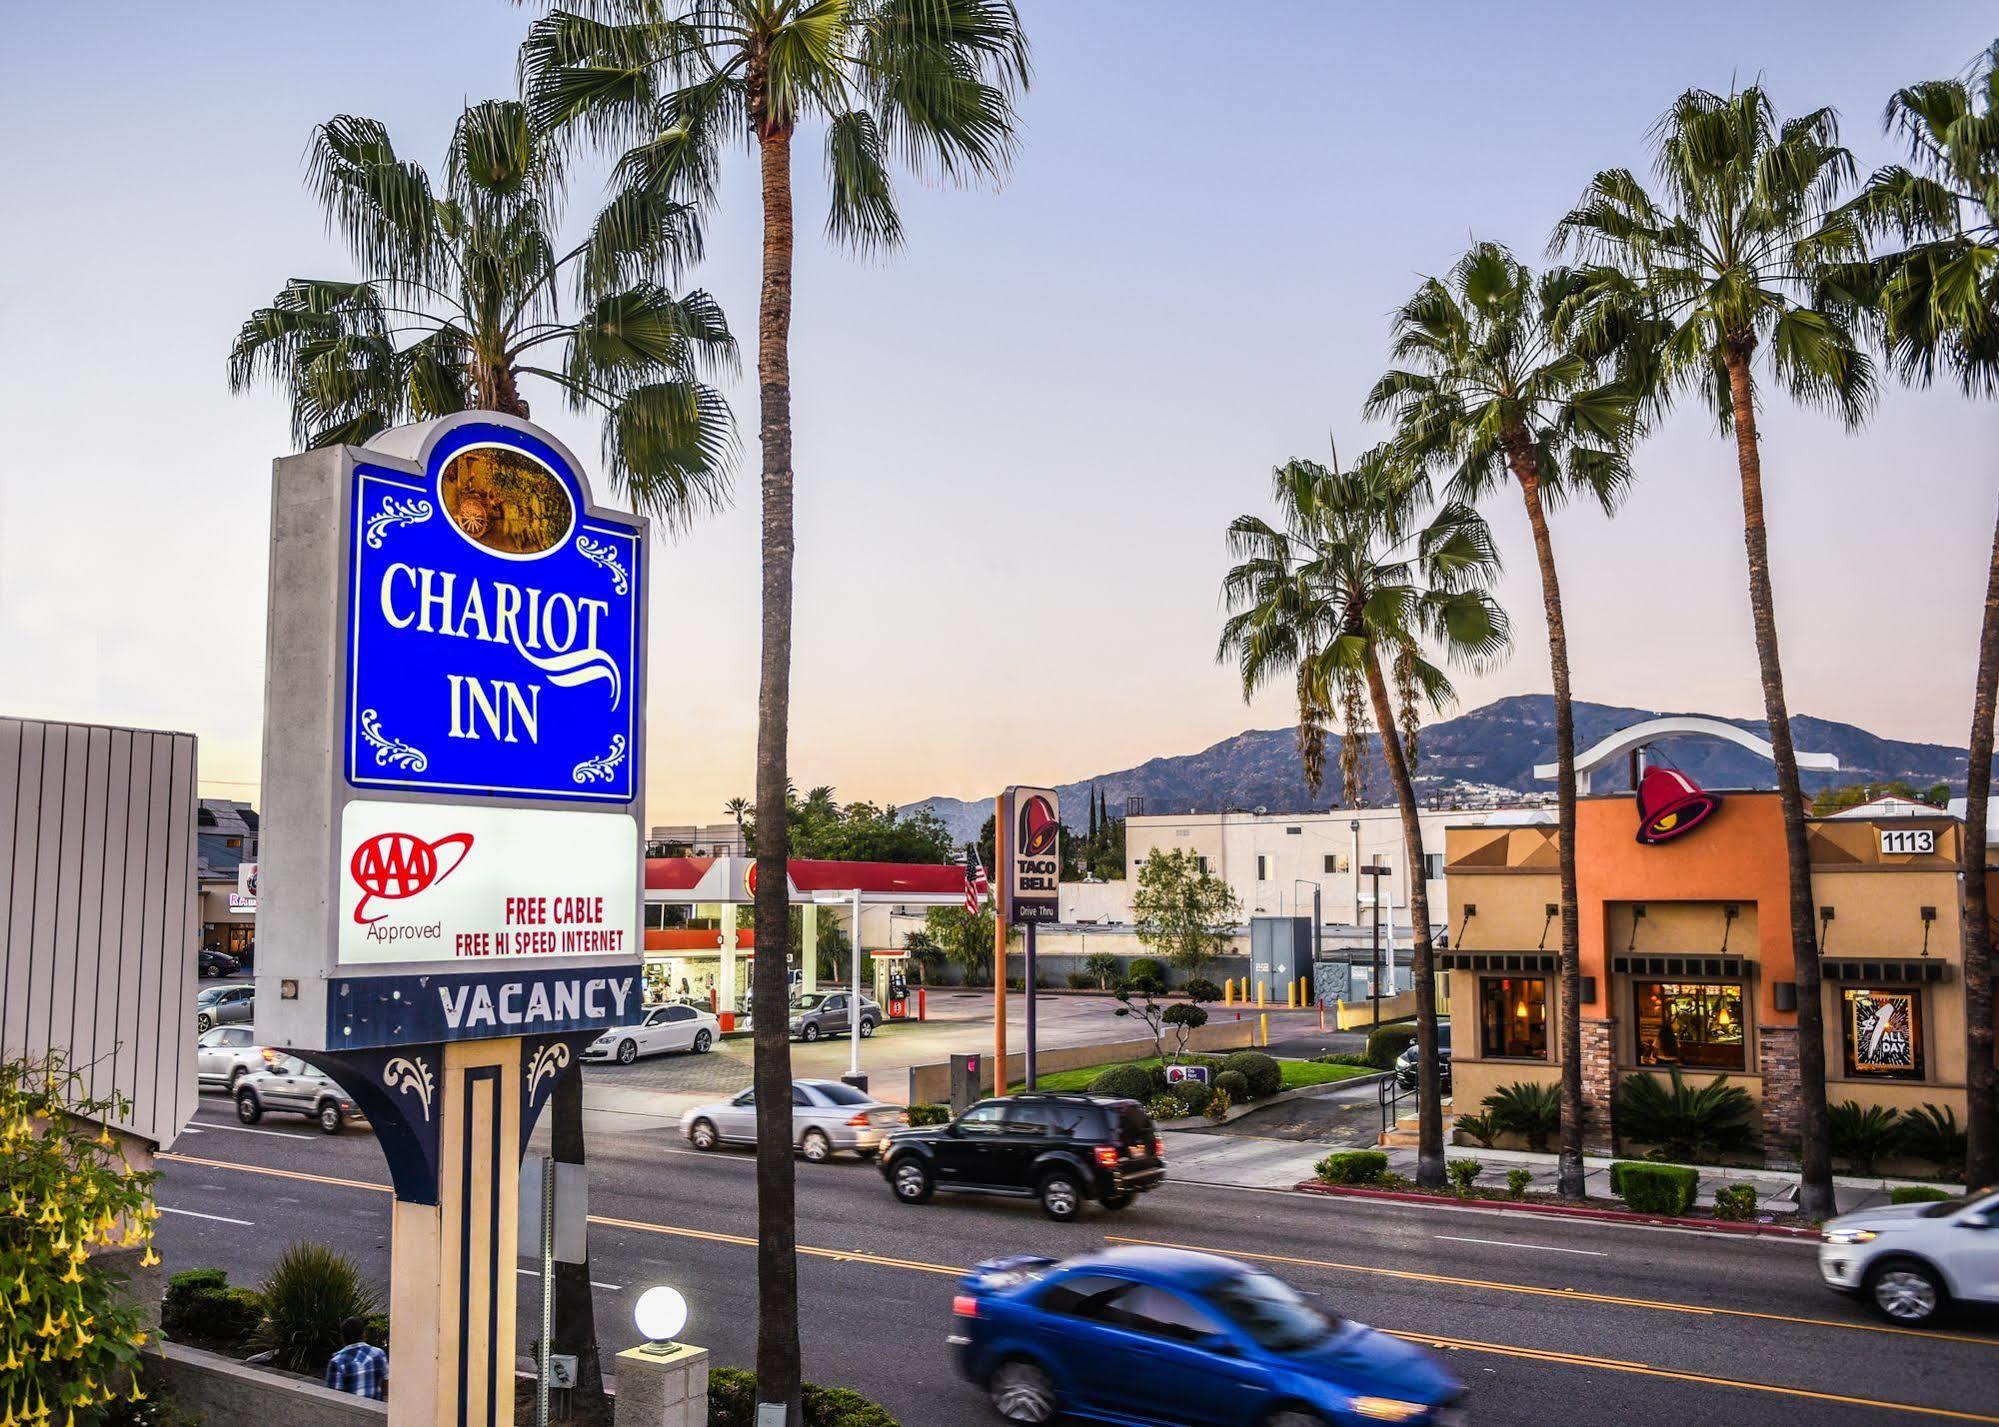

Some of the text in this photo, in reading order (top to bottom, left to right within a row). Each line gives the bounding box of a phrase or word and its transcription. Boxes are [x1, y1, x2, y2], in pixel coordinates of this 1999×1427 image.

[380, 562, 620, 702] CHARIOT
[447, 674, 541, 744] INN
[1883, 832, 1932, 851] 1113
[354, 834, 434, 898] AAA
[1017, 860, 1057, 874] TACO
[1019, 877, 1057, 891] BELL
[506, 897, 603, 925] FREE CABLE
[1020, 905, 1054, 917] Drive Thru
[367, 921, 441, 944] Approved
[456, 930, 623, 956] FREE HI SPEED INTERNET
[438, 977, 634, 1029] VACANCY
[1882, 1032, 1904, 1042] ALL
[1882, 1043, 1906, 1053] DAY
